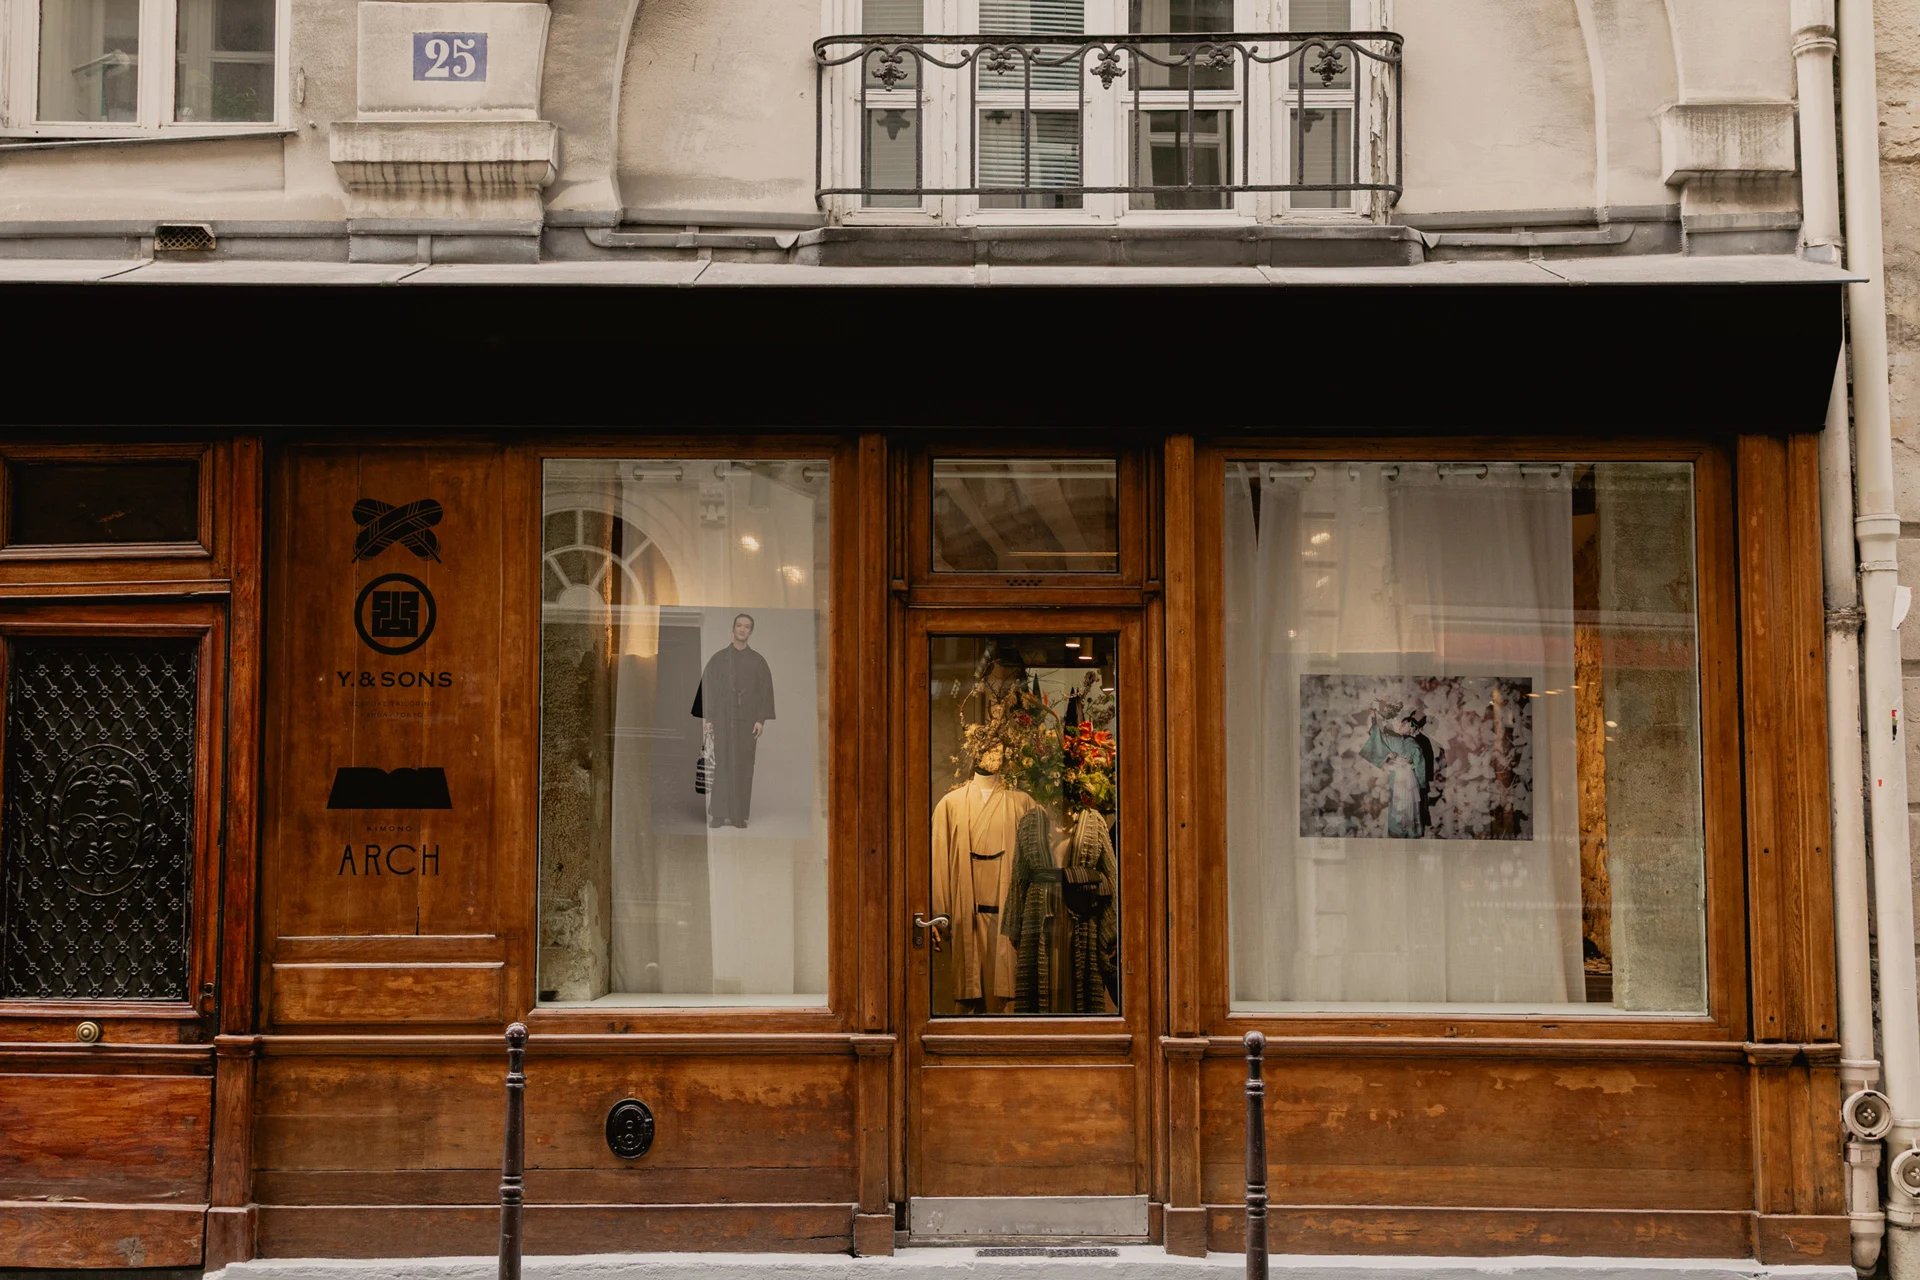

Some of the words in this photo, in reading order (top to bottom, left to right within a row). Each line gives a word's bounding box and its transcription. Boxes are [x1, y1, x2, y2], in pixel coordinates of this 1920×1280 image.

[424, 38, 476, 78] 25
[358, 671, 375, 687] &
[380, 671, 453, 687] SONS
[338, 843, 440, 876] ARCH
